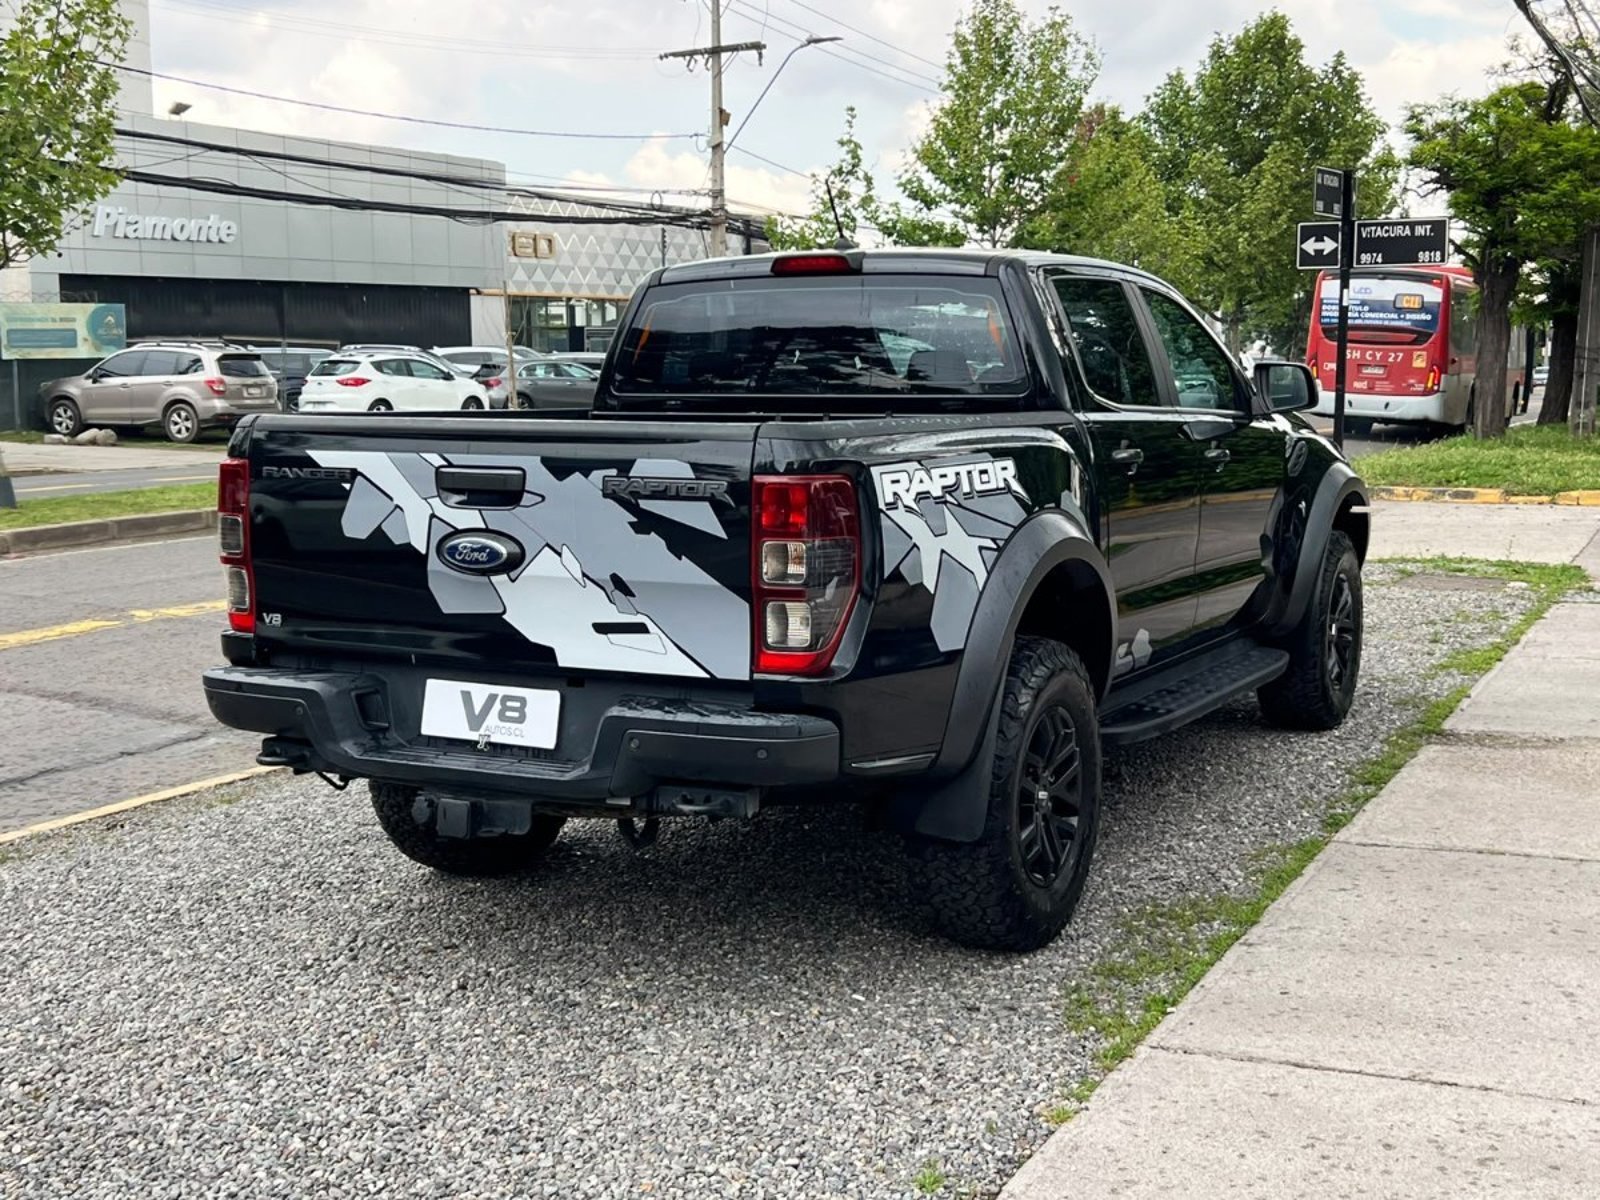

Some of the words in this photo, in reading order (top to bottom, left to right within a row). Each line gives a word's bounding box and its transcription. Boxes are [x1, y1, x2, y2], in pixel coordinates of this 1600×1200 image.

[92, 205, 238, 243] Piamonte
[1361, 225, 1411, 238] VITACURA
[1414, 224, 1434, 236] INT.
[1360, 252, 1382, 264] 9974
[1418, 250, 1441, 262] 9818
[1388, 352, 1404, 362] 27
[262, 466, 351, 479] RANGER
[603, 477, 736, 508] RAPTOR
[879, 459, 1032, 520] RAPTOR
[455, 543, 490, 560] Ford
[262, 612, 282, 626] V8
[460, 690, 528, 732] V8
